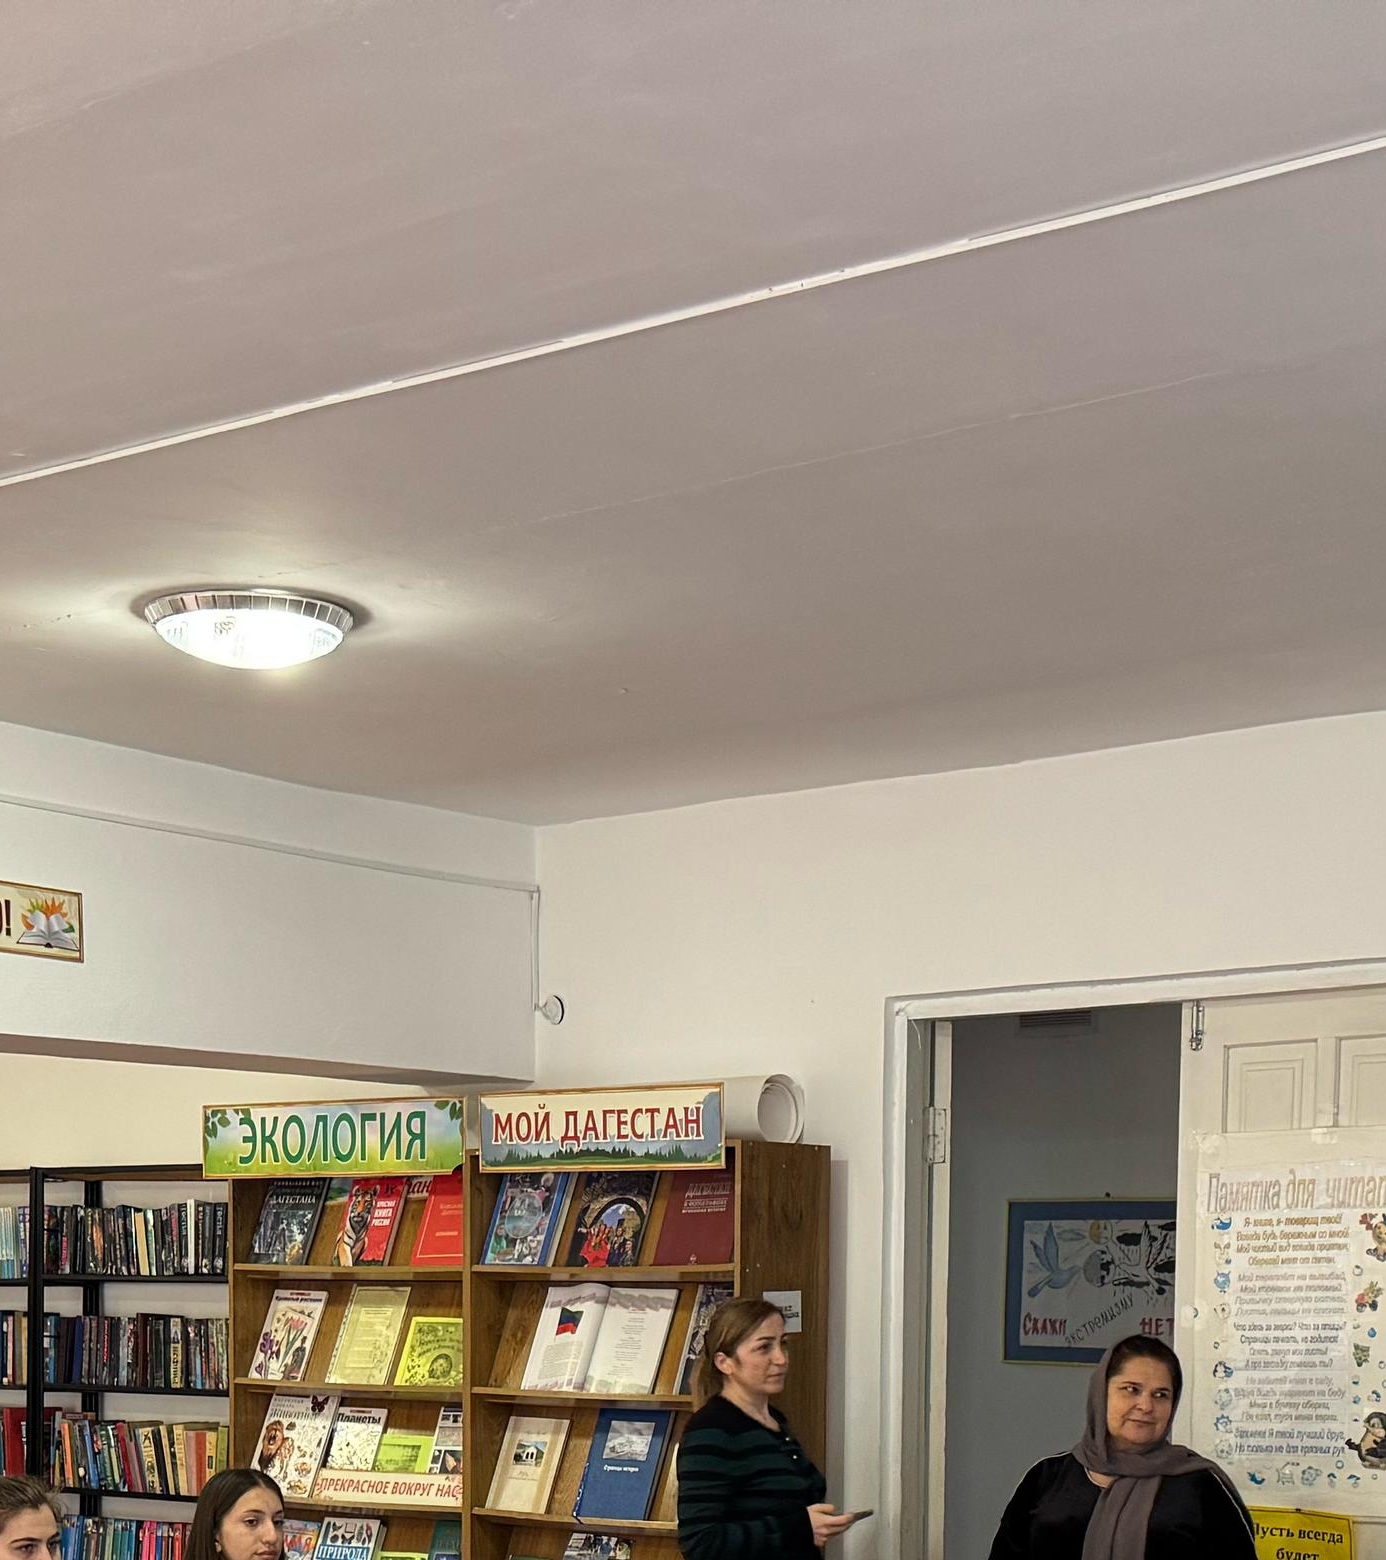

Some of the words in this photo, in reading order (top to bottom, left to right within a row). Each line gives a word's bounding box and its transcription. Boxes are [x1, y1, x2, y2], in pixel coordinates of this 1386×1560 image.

[493, 1103, 553, 1146] МОЙ
[560, 1104, 705, 1149] ДАГЕСТАН
[238, 1109, 428, 1166] ЭКОЛОГИЯ
[1207, 1173, 1282, 1213] Памятка
[337, 1413, 381, 1424] Планеты
[319, 1477, 389, 1495] ПРЕКРАСНОЕ
[391, 1482, 434, 1497] ВОКРУГ
[1298, 1529, 1343, 1544] всегда
[318, 1545, 367, 1560] ПРИРОДА
